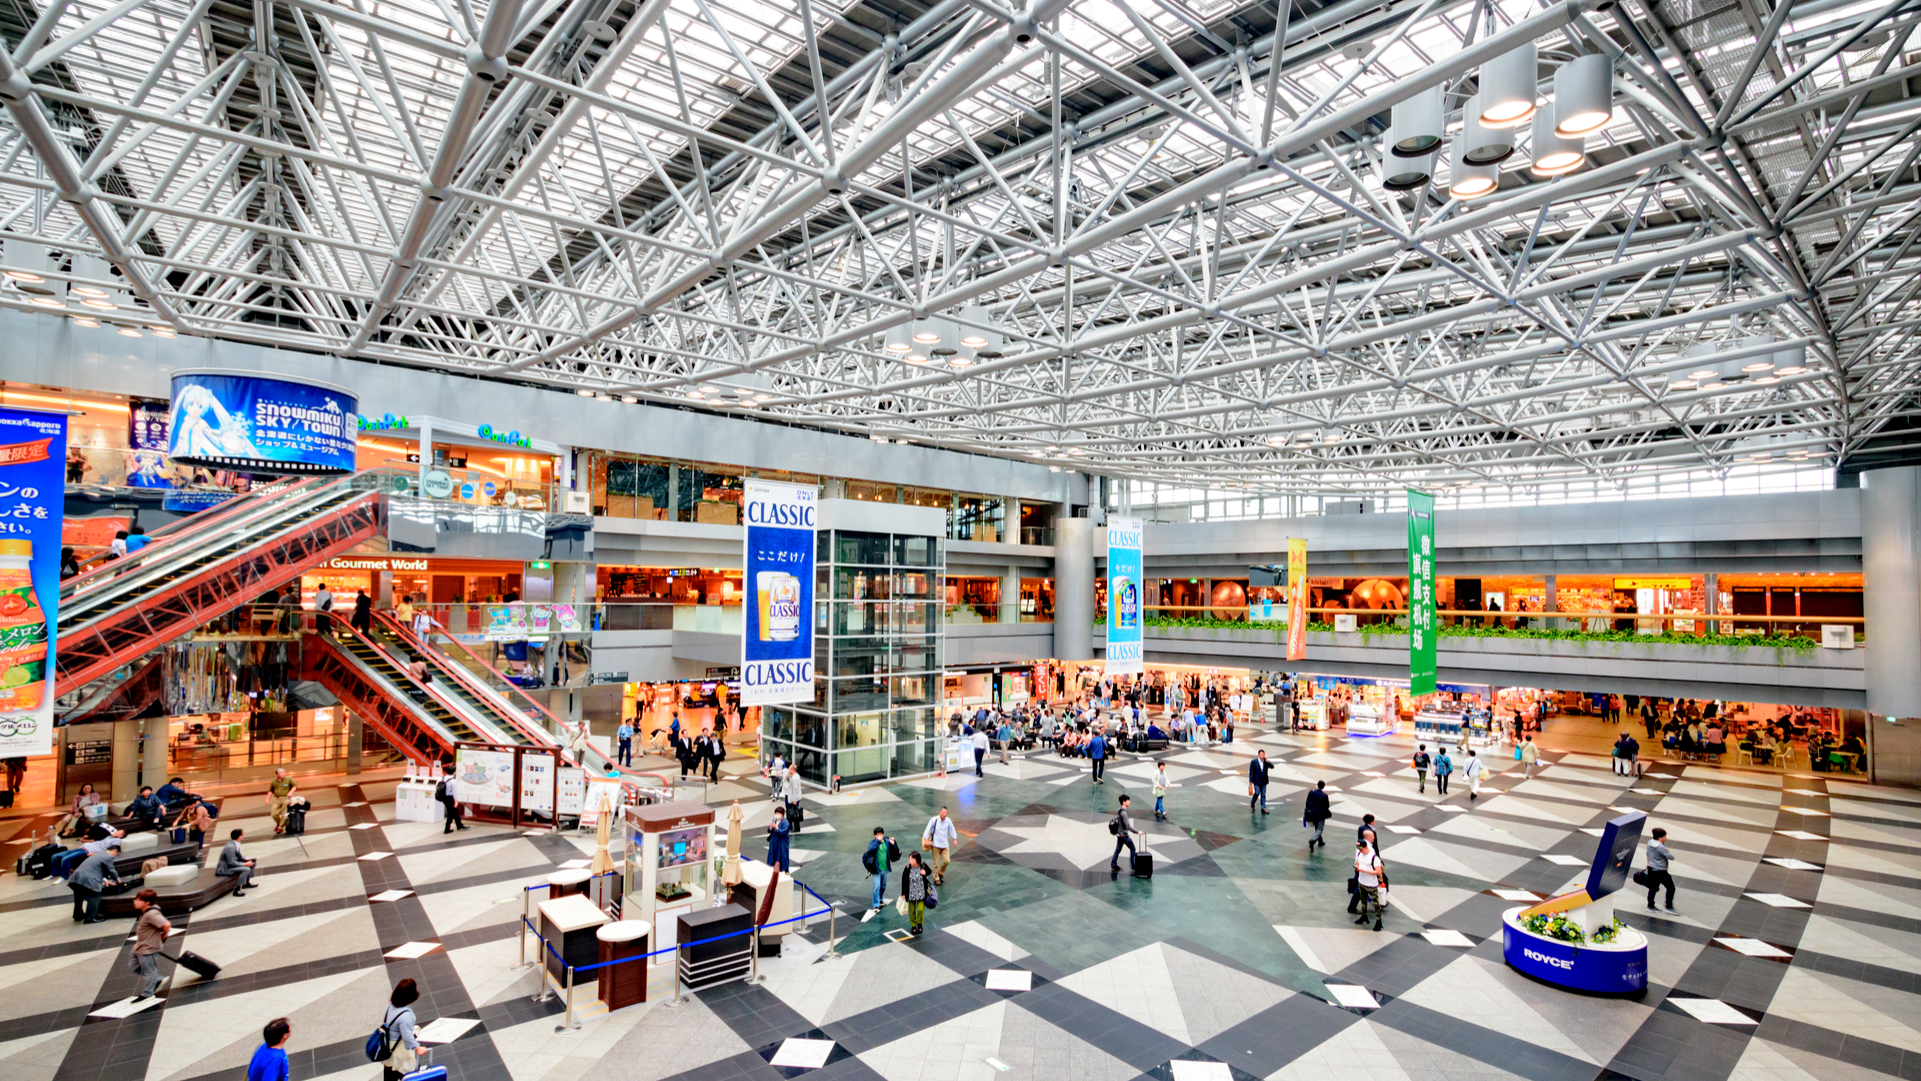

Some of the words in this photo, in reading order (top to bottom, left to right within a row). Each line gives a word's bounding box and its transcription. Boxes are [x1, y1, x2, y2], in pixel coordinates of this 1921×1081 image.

[256, 415, 292, 429] SKY
[301, 420, 341, 438] TOWN
[748, 501, 815, 527] CLASSIC
[1109, 530, 1141, 547] CLASSIC
[330, 558, 388, 569] Gourmet
[391, 559, 428, 570] World
[770, 605, 799, 617] CLASSIC
[1108, 643, 1141, 660] CLASSIC
[745, 662, 811, 686] CLASSIC
[1037, 666, 1046, 694] 宝くじ
